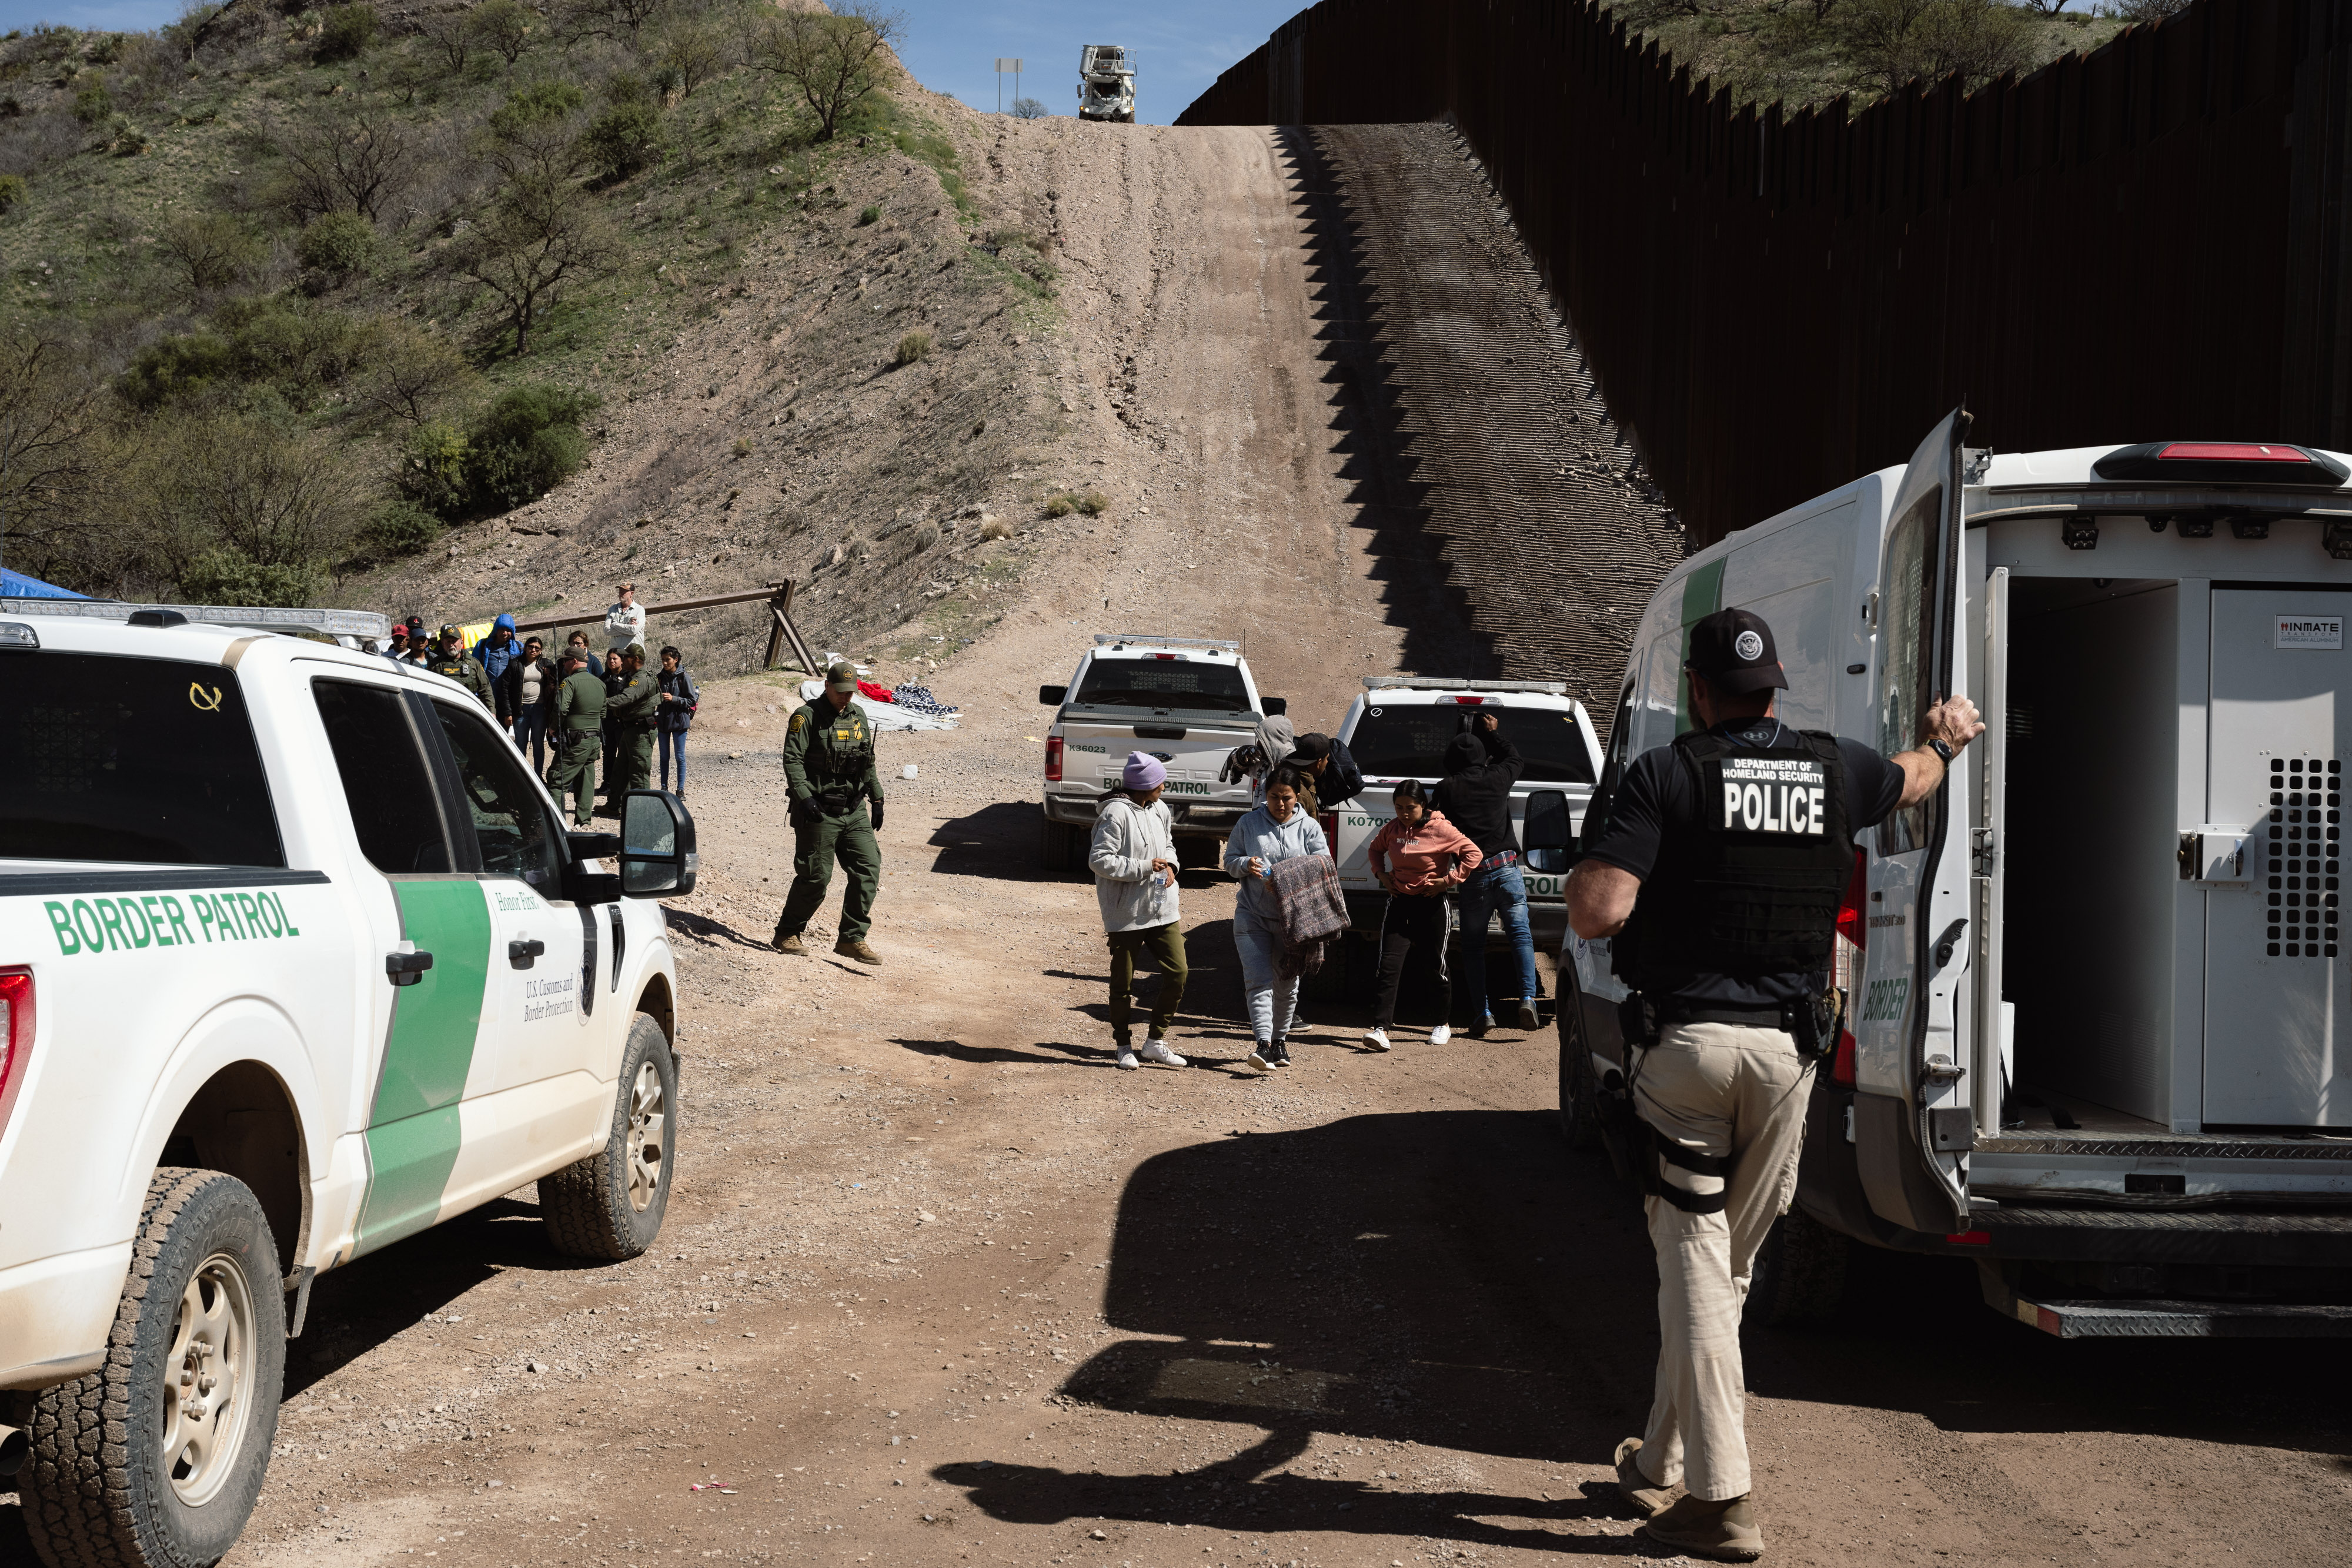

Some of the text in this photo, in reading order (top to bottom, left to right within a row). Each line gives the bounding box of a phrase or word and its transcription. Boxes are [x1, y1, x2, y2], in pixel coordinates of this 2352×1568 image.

[2290, 623, 2338, 632] INMATE
[1069, 745, 1106, 753] K36023
[1734, 759, 1812, 771] DEPARTMENT OF
[1722, 769, 1823, 784] HOMELAND SECURITY
[1164, 781, 1211, 795] PATROL
[1725, 783, 1825, 834] POLICE
[495, 892, 521, 911] Honor
[43, 892, 300, 956] BORDER PATROL
[526, 972, 573, 999] U.S. Customs and
[1863, 977, 1908, 1021] BORDER
[524, 997, 573, 1022] Border Protection
